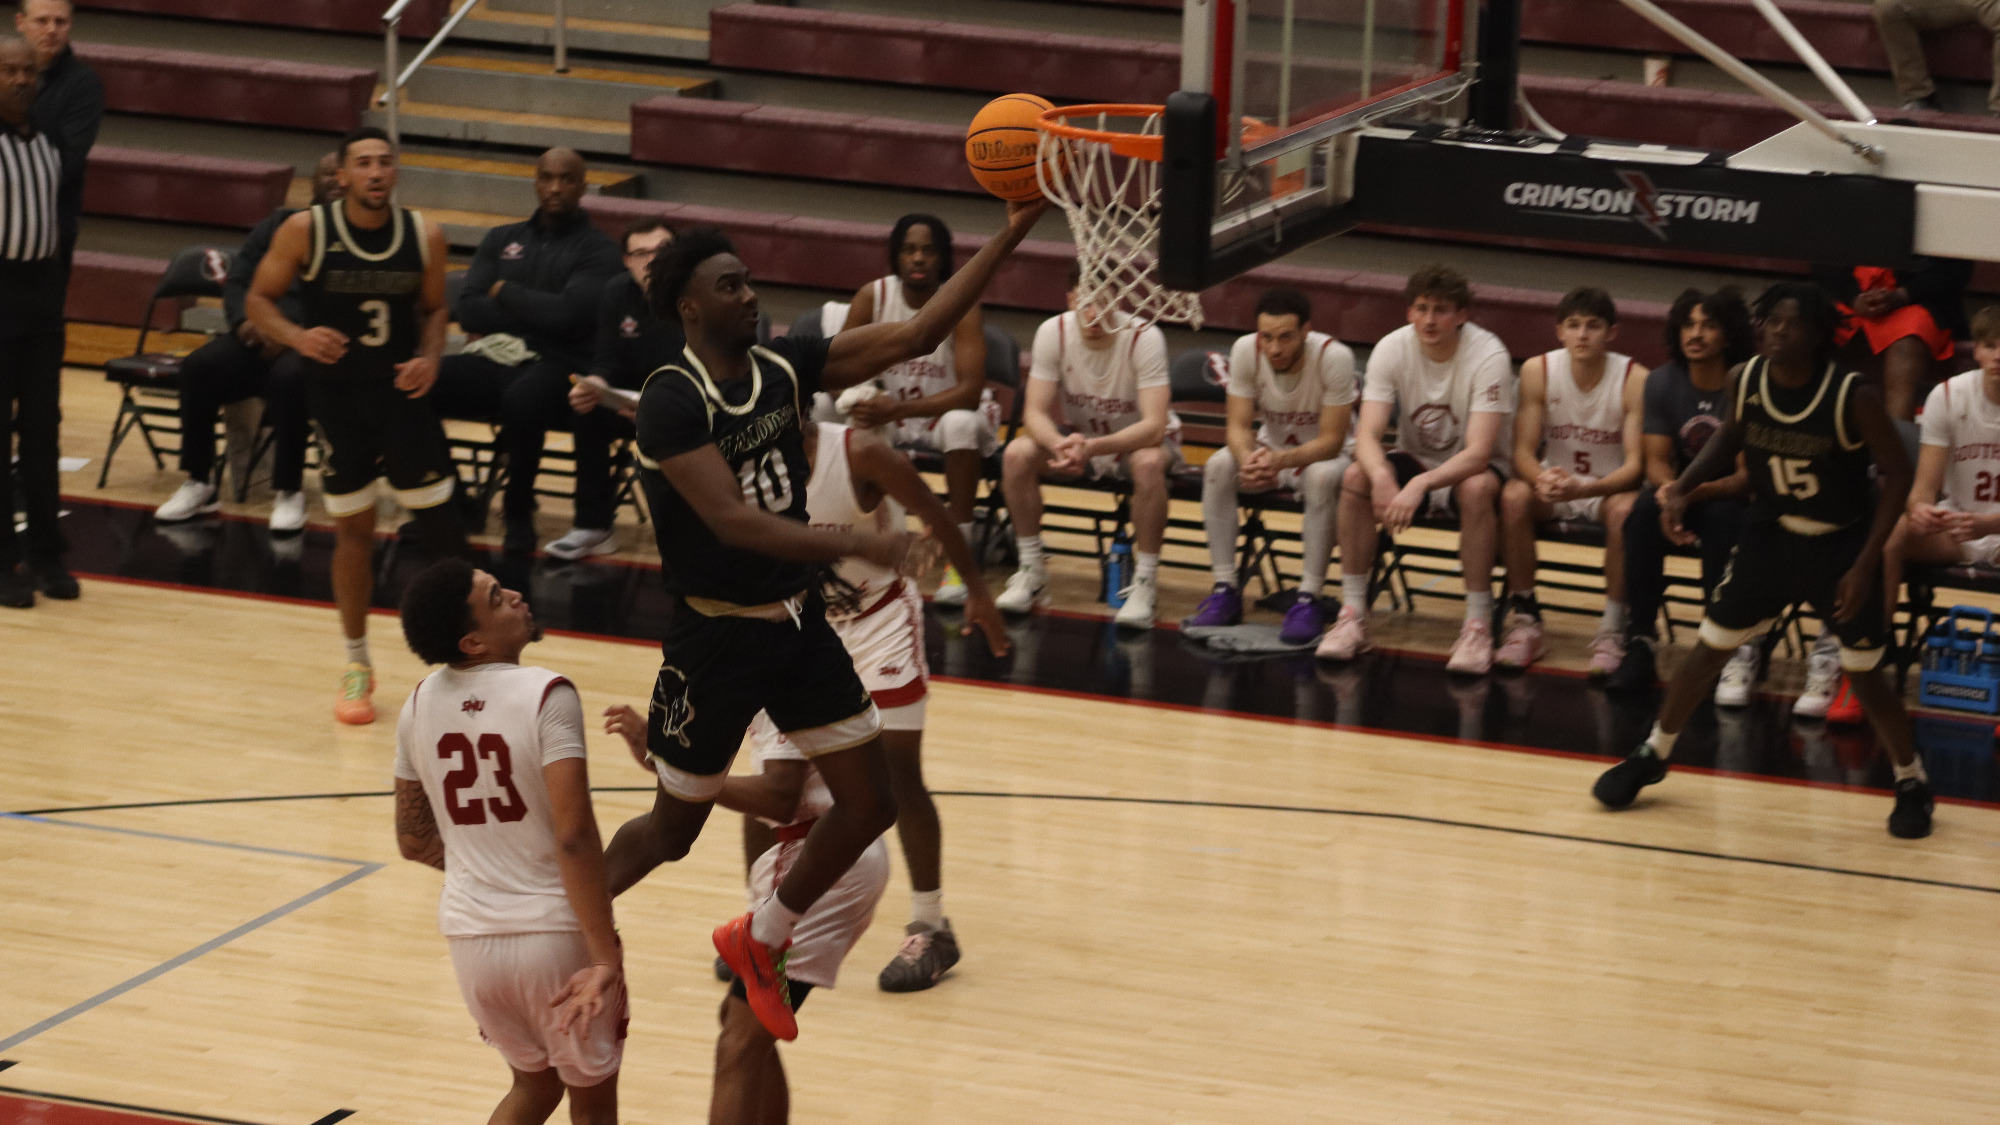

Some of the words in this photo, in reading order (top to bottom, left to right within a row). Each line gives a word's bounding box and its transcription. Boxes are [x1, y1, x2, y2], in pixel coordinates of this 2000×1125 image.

[1504, 182, 1636, 214] CRIMSON
[1655, 194, 1761, 224] STORM
[358, 299, 391, 347] 3
[738, 447, 793, 513] 10
[1574, 451, 1591, 475] 5
[1767, 455, 1820, 500] 15
[436, 732, 528, 826] 23
